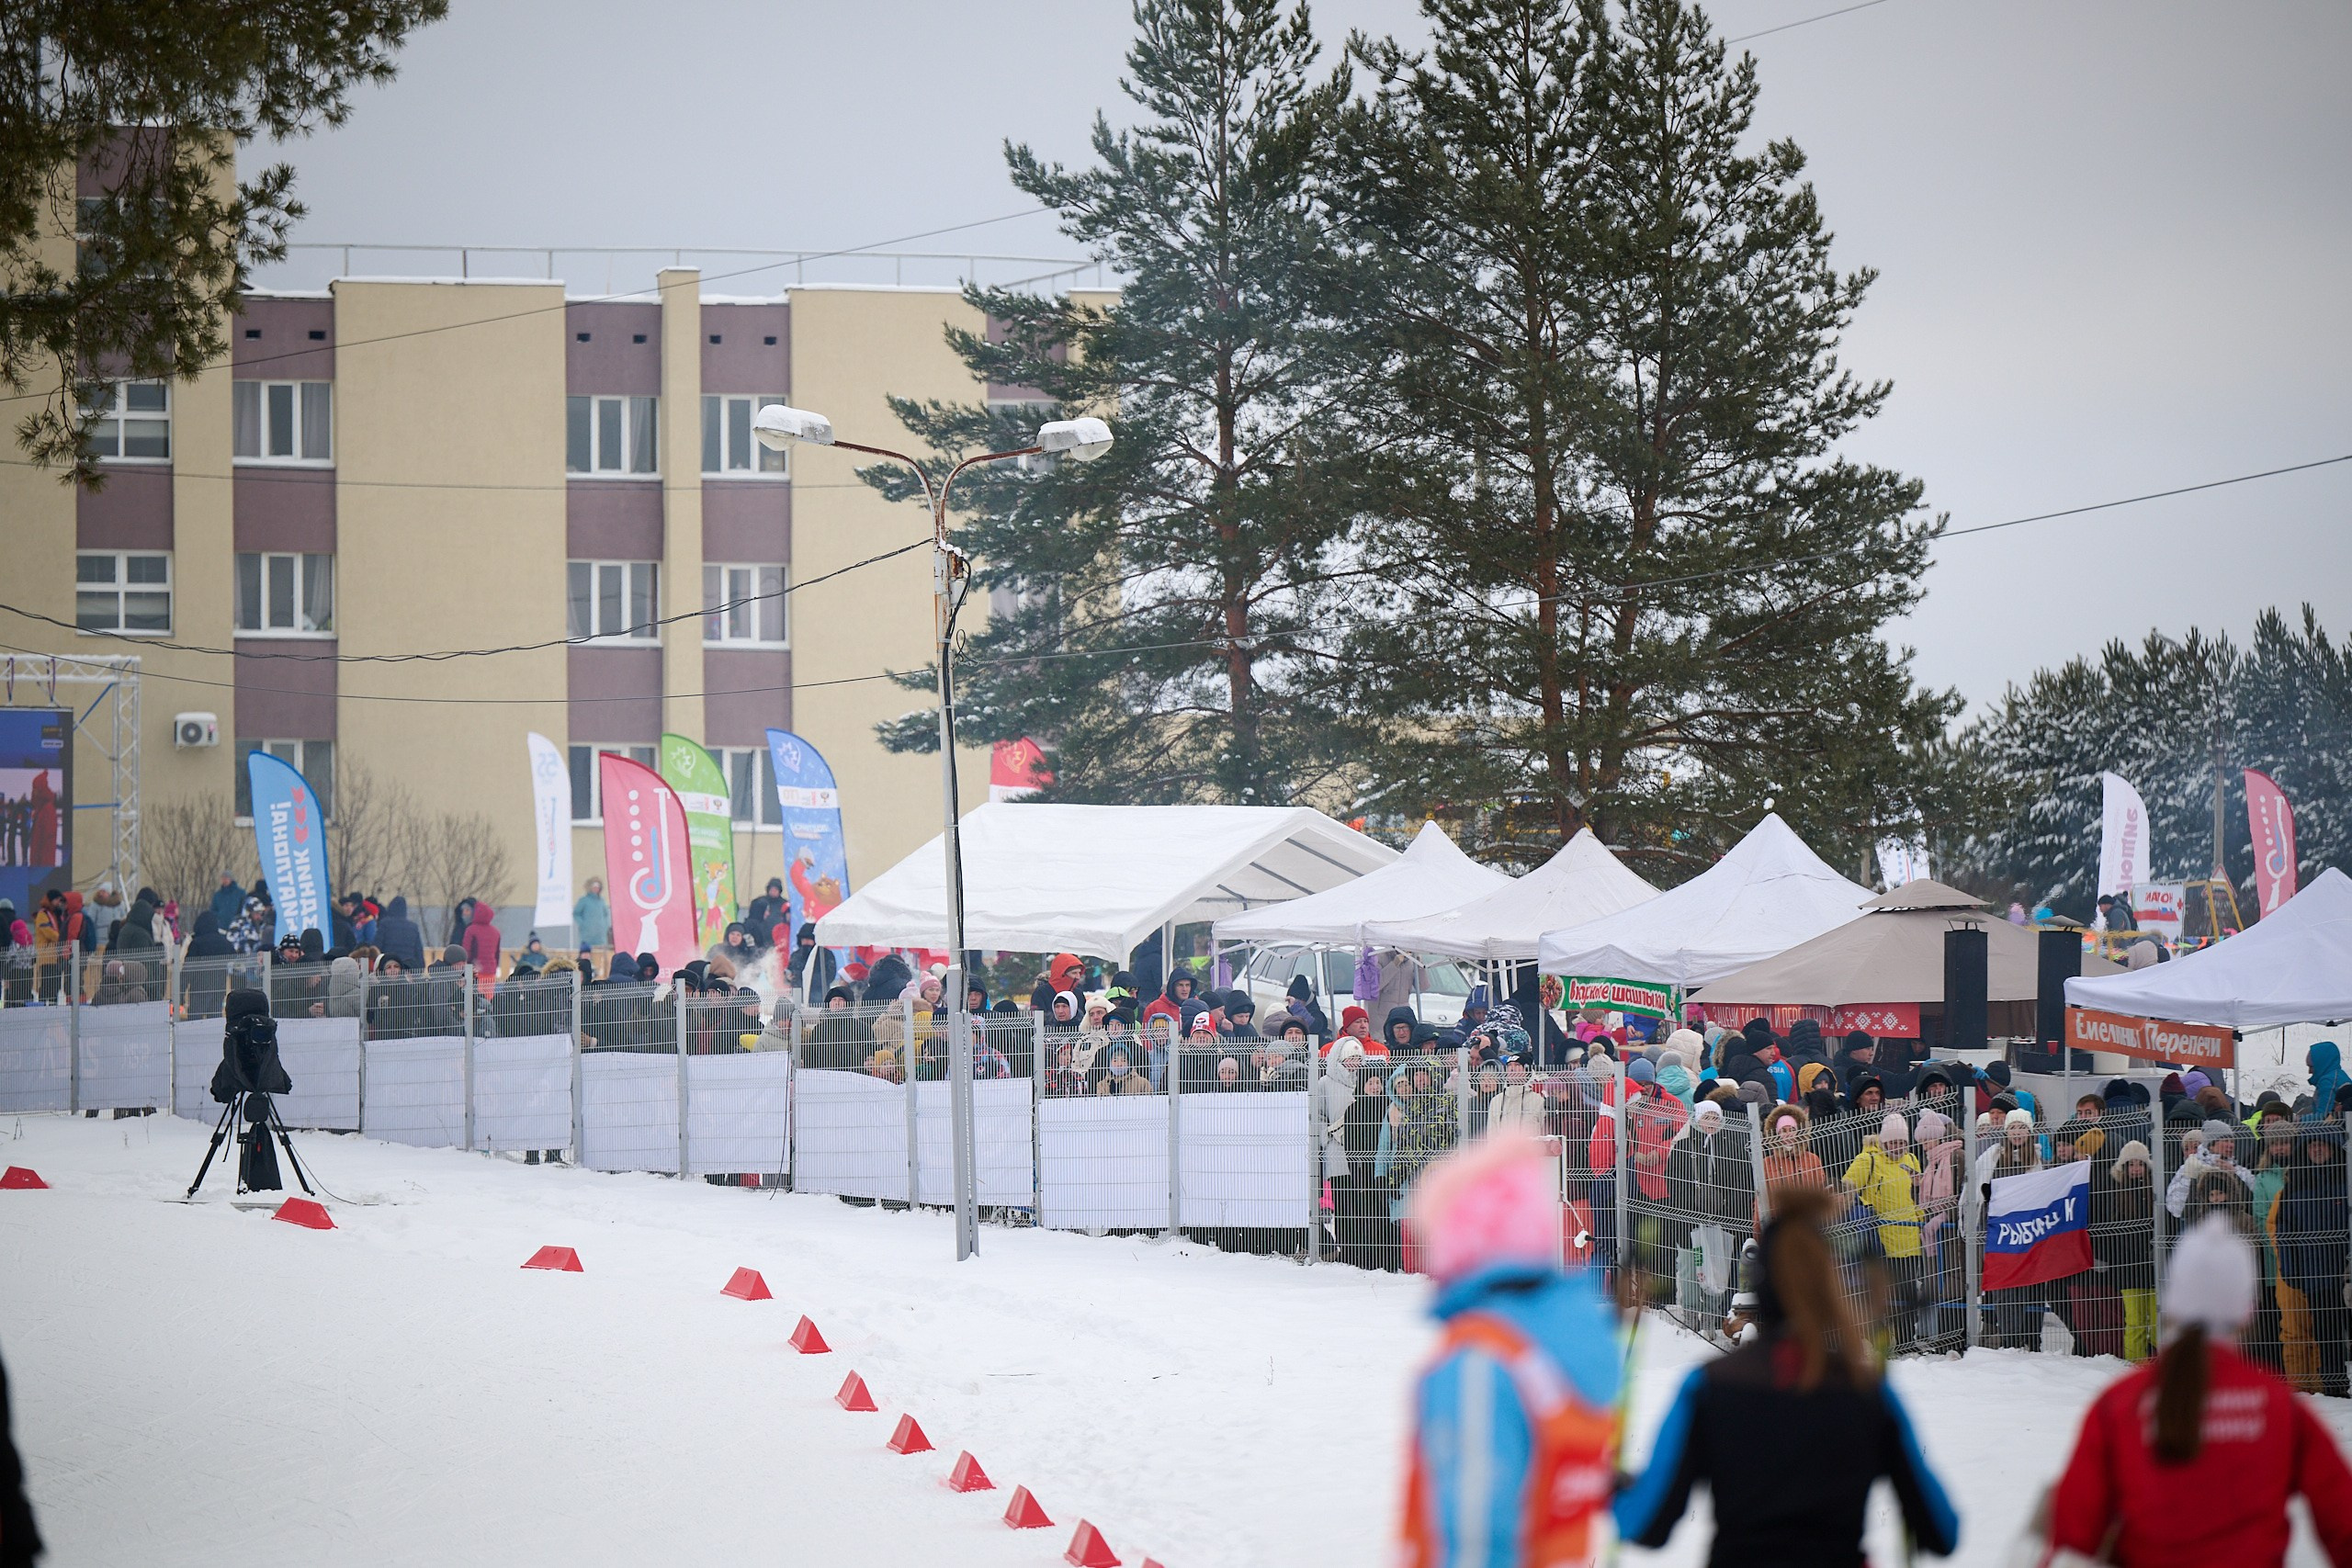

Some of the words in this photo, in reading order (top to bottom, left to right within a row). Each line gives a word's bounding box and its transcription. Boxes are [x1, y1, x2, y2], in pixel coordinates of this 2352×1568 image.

[1774, 1007, 1781, 1028] И
[2144, 1022, 2222, 1061] Перепечи
[1767, 1066, 1785, 1075] SSIA
